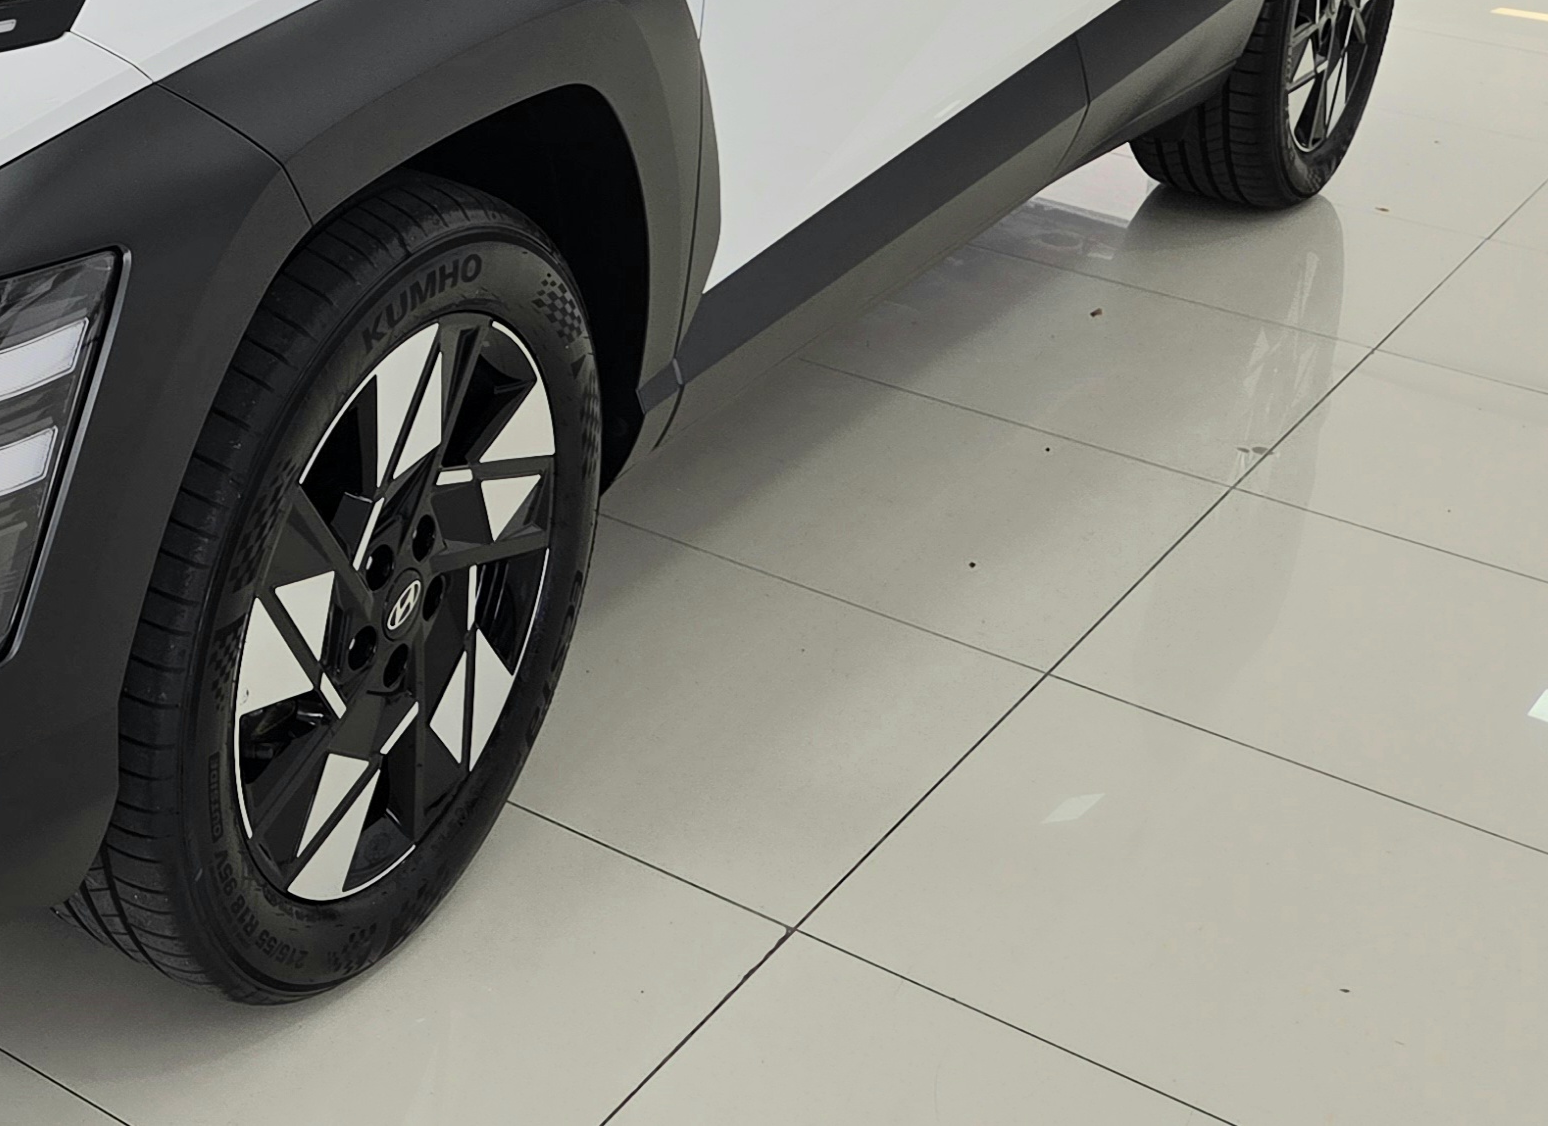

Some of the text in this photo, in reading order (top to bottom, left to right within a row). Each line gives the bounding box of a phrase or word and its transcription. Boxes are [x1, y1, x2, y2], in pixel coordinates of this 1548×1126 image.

[362, 253, 482, 354] KUMHO
[214, 849, 238, 896] 95V
[231, 893, 261, 935] R18
